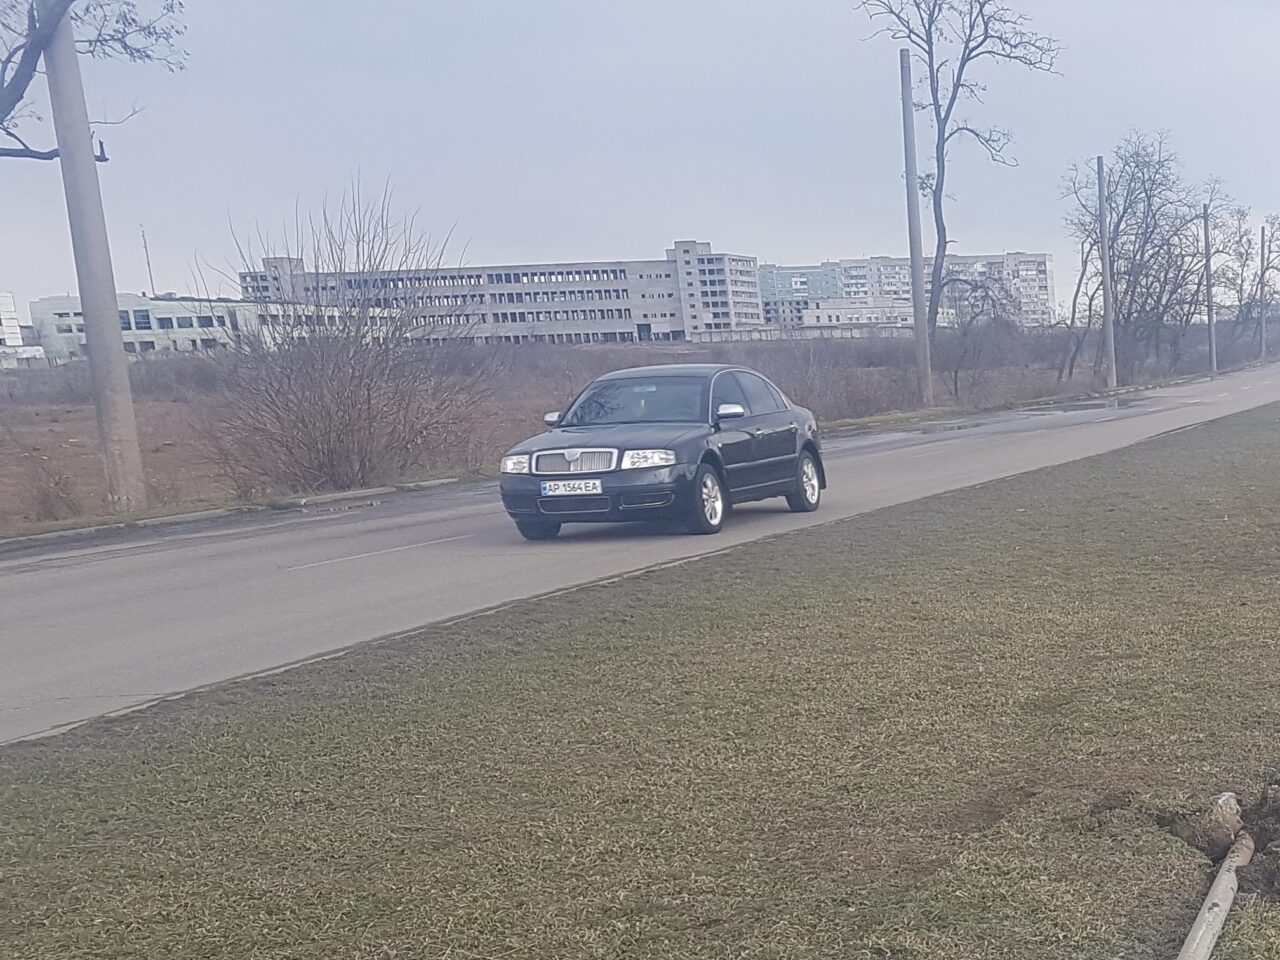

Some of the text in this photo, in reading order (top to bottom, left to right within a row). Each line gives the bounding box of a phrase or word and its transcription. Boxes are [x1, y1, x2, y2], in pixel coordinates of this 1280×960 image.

[548, 482, 599, 493] AP 1564 EA
